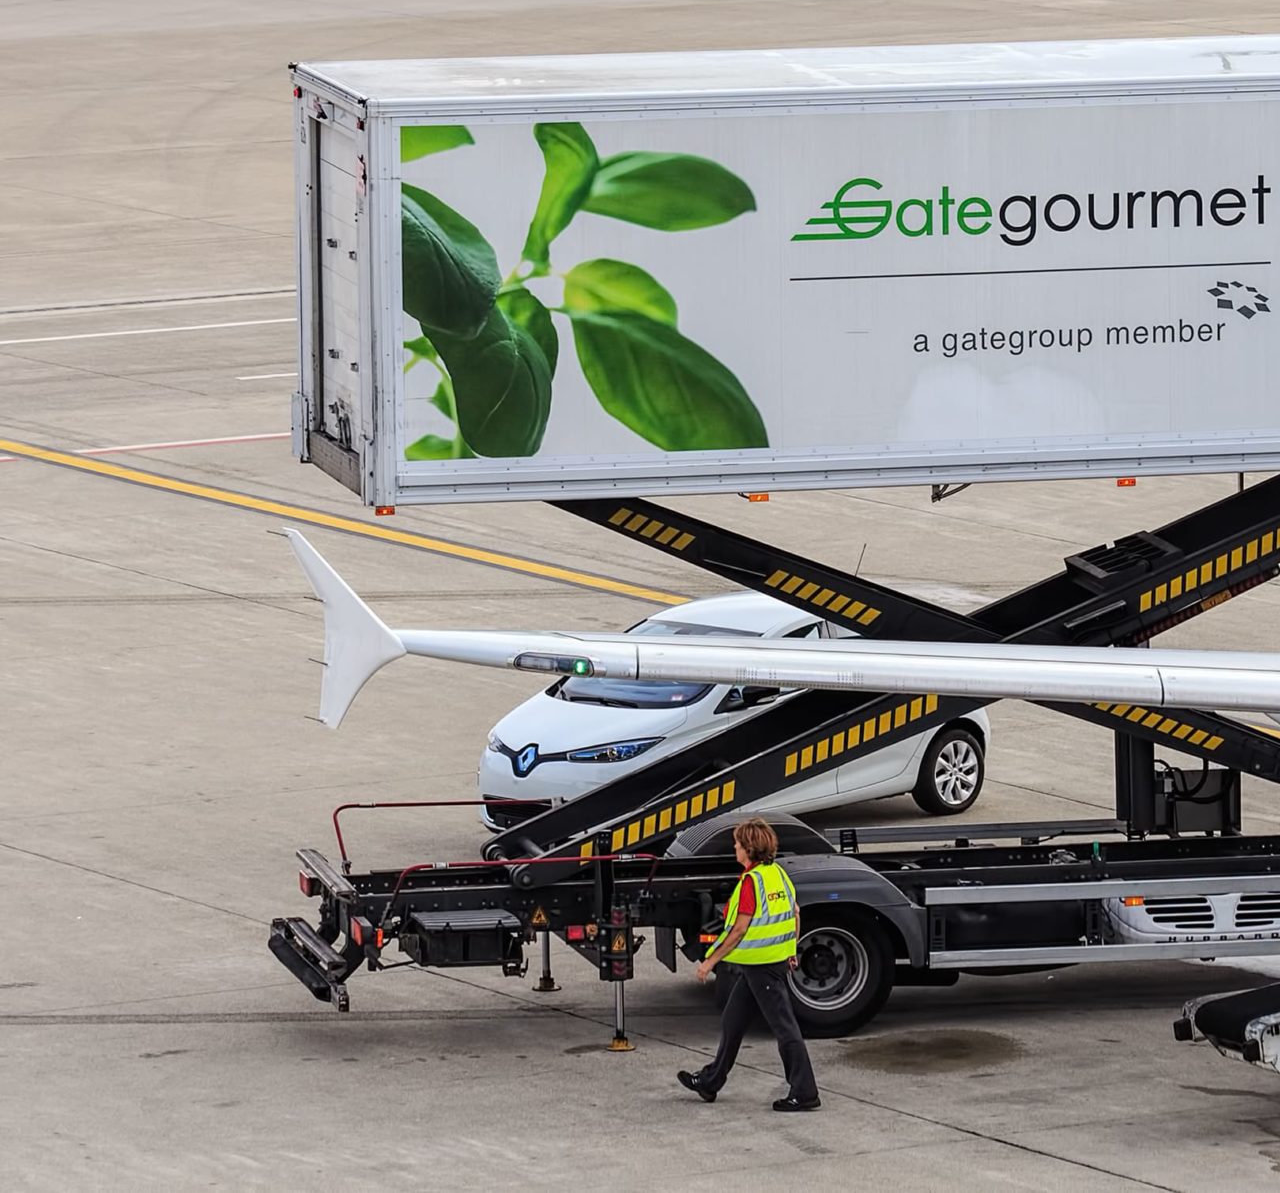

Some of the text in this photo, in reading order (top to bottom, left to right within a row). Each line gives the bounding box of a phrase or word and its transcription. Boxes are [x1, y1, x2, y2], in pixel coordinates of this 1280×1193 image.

[913, 319, 1227, 357] a gategroup member
